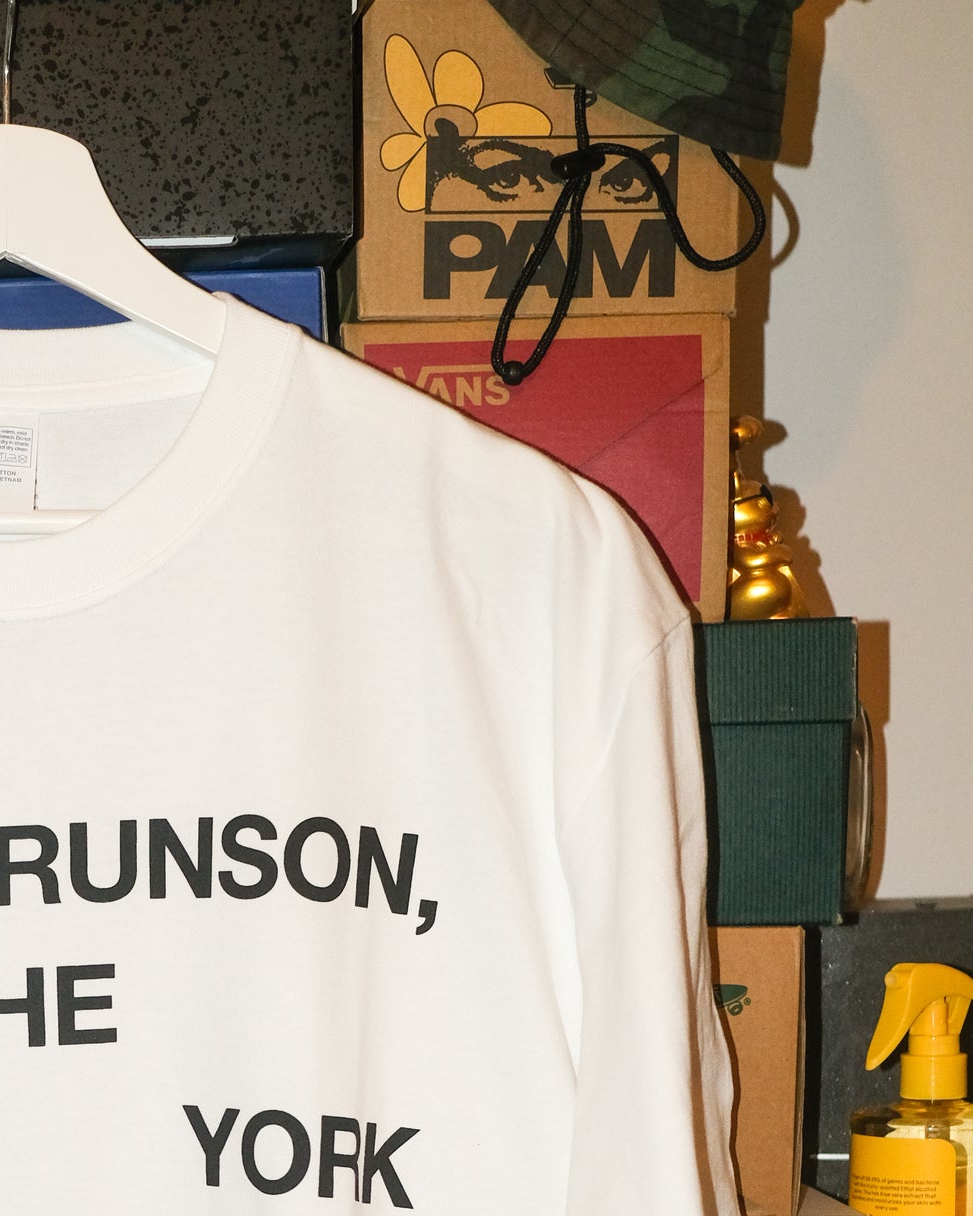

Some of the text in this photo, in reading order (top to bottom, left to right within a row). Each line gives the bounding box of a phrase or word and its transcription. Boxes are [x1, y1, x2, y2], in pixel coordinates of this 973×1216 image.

[423, 219, 676, 300] PAM
[394, 364, 511, 407] VANS
[182, 1105, 420, 1210] YORK
